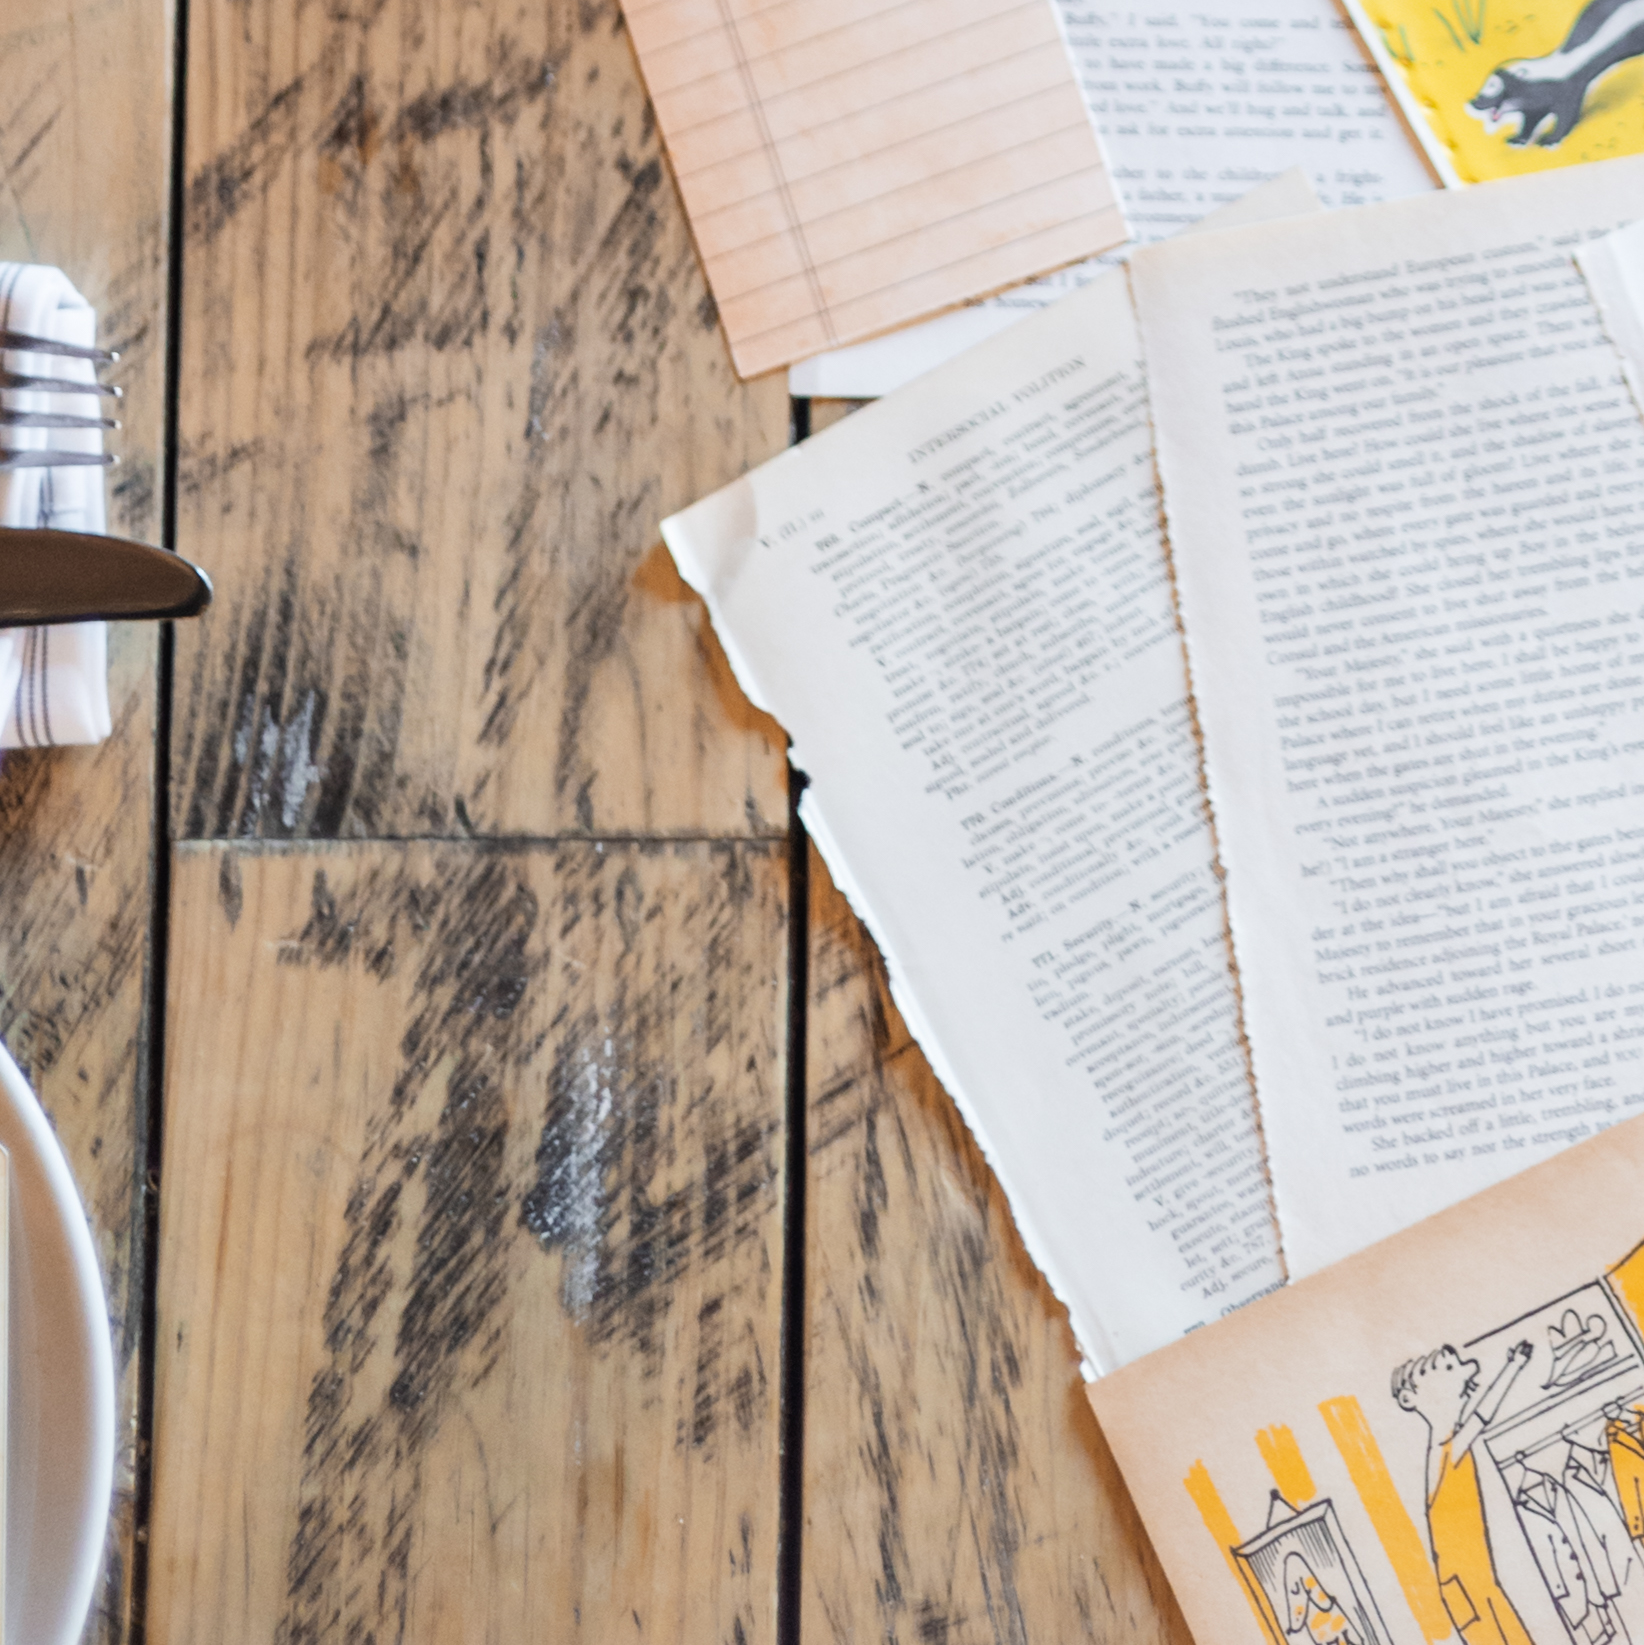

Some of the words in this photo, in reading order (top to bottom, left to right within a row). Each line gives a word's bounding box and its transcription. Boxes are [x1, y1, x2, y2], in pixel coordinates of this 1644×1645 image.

[906, 399, 1009, 465] INTERSOCIAL
[1010, 354, 1087, 403] VOLITION
[1265, 644, 1321, 670] Consul
[1320, 638, 1352, 657] and
[1350, 635, 1378, 651] the
[1377, 622, 1452, 646] American
[1453, 605, 1549, 632] missionaries.
[1324, 1007, 1354, 1028] and
[1355, 999, 1406, 1026] purple
[1406, 992, 1444, 1012] with
[1444, 984, 1500, 1006] sudden
[1500, 979, 1537, 997] rage.
